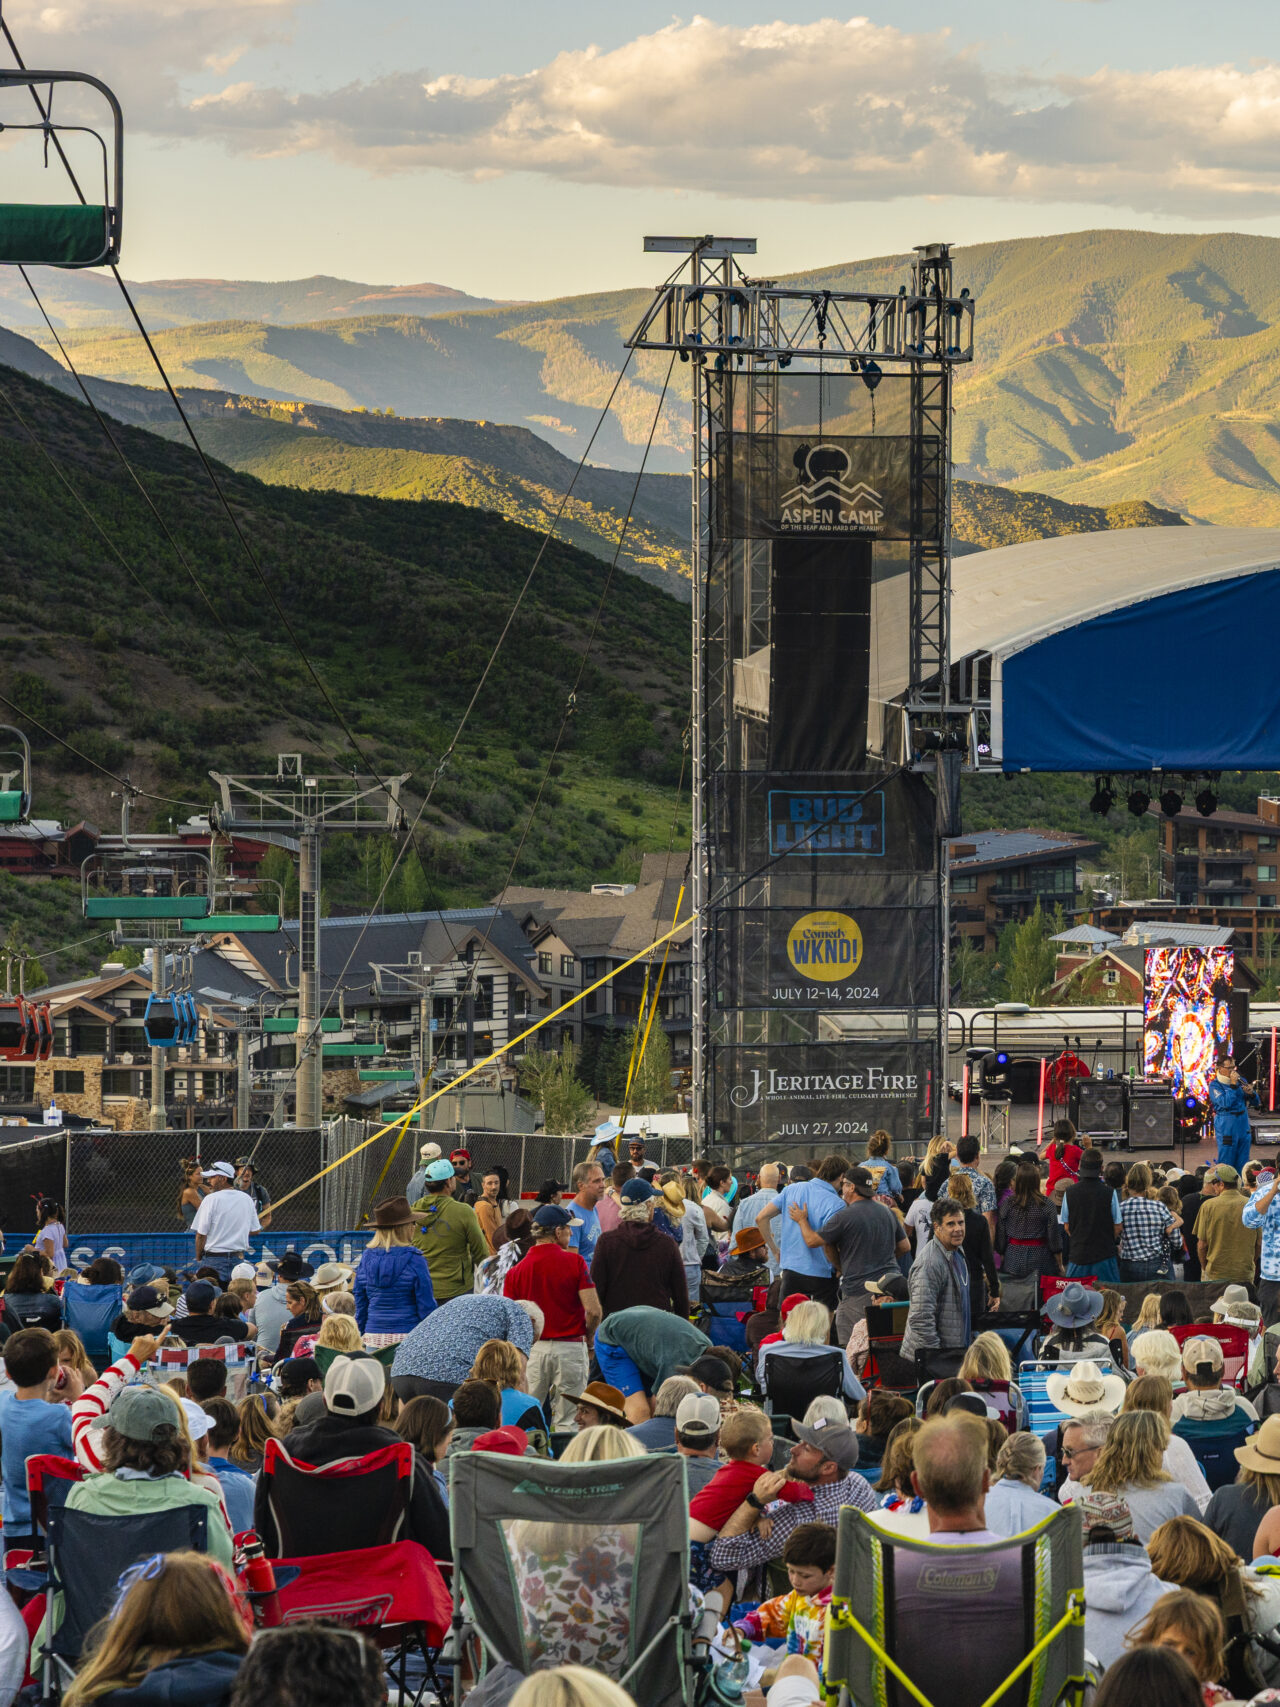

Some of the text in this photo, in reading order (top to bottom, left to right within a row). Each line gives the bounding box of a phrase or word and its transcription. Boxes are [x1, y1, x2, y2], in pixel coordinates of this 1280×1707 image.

[781, 508, 884, 525] ASPEN CAMP
[789, 798, 863, 823] BUD
[776, 823, 877, 849] LIGHT
[802, 928, 847, 939] Comedy
[793, 938, 857, 964] WKND!
[772, 987, 880, 1001] JULY 12-14, 2024
[778, 1121, 869, 1137] JULY 27, 2024
[924, 1567, 981, 1586] Coleman
